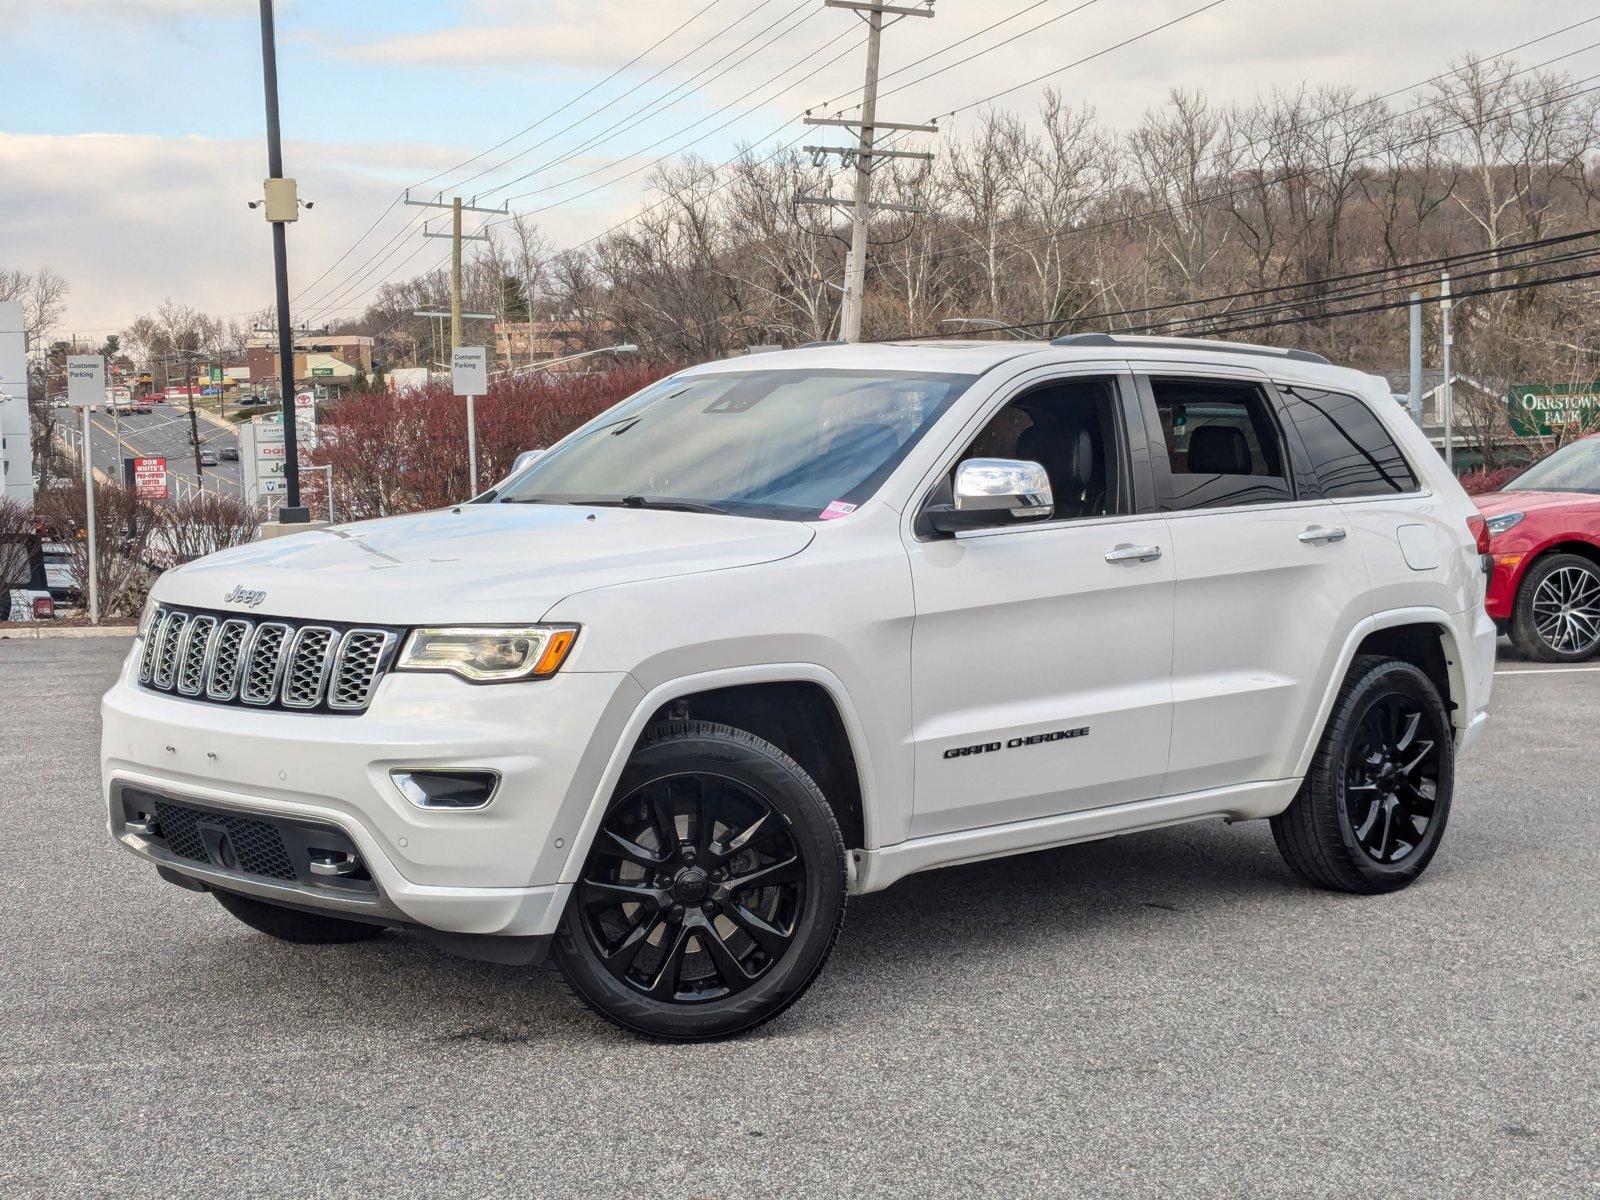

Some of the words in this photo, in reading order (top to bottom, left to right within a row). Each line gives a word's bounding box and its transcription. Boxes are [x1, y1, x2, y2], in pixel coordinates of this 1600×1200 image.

[454, 362, 476, 370] Parking
[69, 371, 94, 379] Parking
[224, 584, 267, 609] Jeep
[943, 741, 1002, 759] GRAND
[1006, 726, 1090, 749] CHEROKEE
